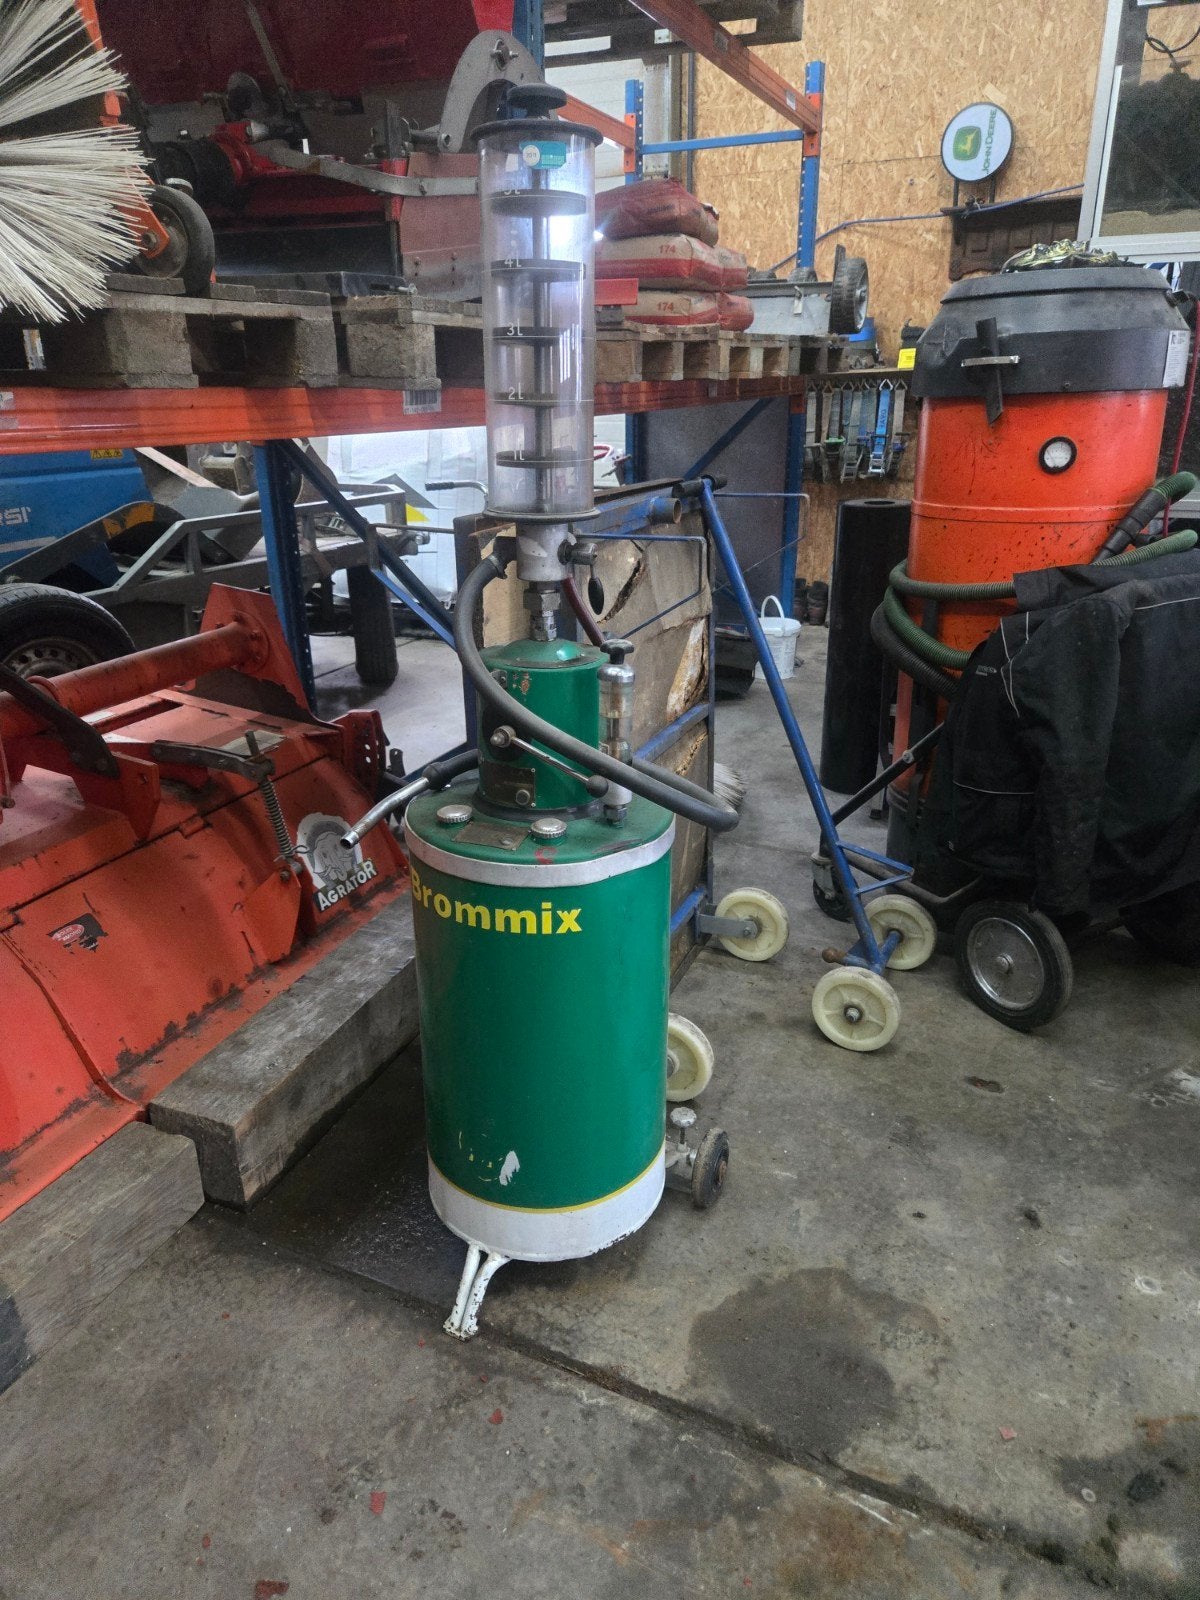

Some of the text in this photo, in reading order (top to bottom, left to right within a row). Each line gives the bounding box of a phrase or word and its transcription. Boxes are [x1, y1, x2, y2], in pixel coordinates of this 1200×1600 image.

[982, 108, 997, 174] JOHN DEERE
[660, 245, 676, 254] 174
[657, 302, 674, 311] 174
[317, 860, 377, 911] AGRATOR
[411, 866, 582, 935] Brommix
